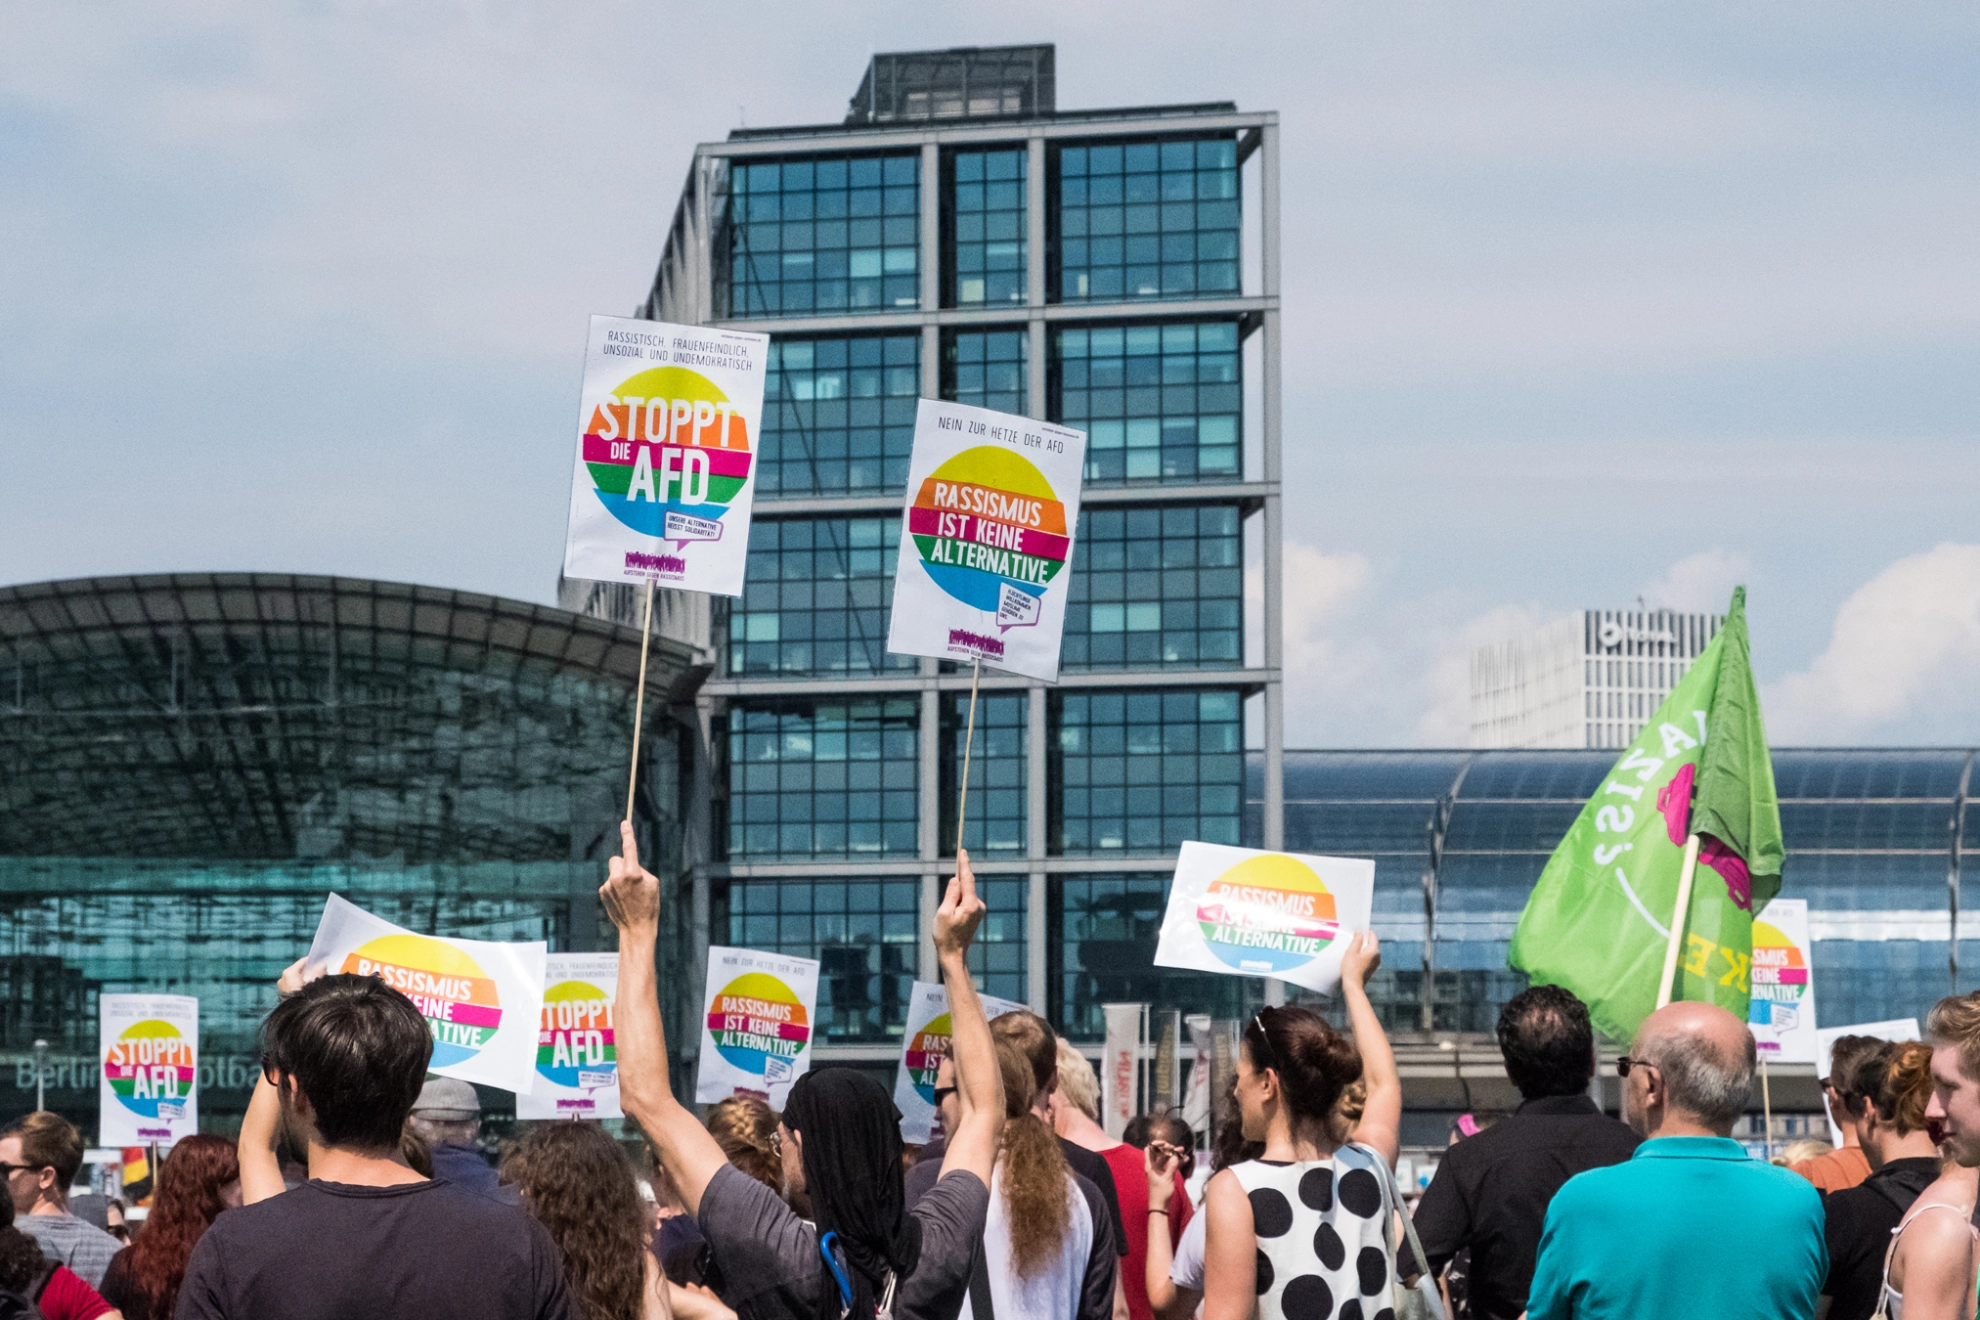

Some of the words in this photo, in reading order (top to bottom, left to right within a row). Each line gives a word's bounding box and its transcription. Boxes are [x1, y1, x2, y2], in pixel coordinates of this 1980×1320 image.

[603, 344, 644, 359] UNSOZIAL
[650, 349, 668, 361] UND
[673, 352, 752, 371] UNDEMOKRATISCH
[598, 395, 736, 448] STOPPT
[938, 416, 963, 432] NEIN
[968, 421, 986, 436] ZUR
[991, 426, 1018, 443] HETZE
[1024, 433, 1042, 448] DER
[1046, 439, 1064, 454] AFD
[610, 441, 630, 461] DIE
[626, 446, 710, 506] AFD
[933, 482, 1042, 526] RASSISMUS
[937, 512, 970, 536] IST
[975, 519, 1024, 552] KEINE
[930, 538, 1049, 584] ALTERNATIVE
[1219, 884, 1316, 916] RASSISMUS
[1212, 925, 1320, 954] ALTERNATIVE
[409, 993, 455, 1021] EINE
[926, 993, 943, 1002] NEIN
[1751, 984, 1800, 1001] RNATIVE
[538, 998, 617, 1031] TOPPT
[721, 996, 792, 1022] RASSISMUS
[724, 1014, 745, 1031] IST
[748, 1017, 781, 1037] KEINE
[110, 1036, 189, 1067] STOPPT
[552, 1030, 605, 1069] AFD
[720, 1031, 798, 1056] ALTERNATIVE
[120, 1066, 133, 1077] DIE
[133, 1065, 179, 1100] AFD
